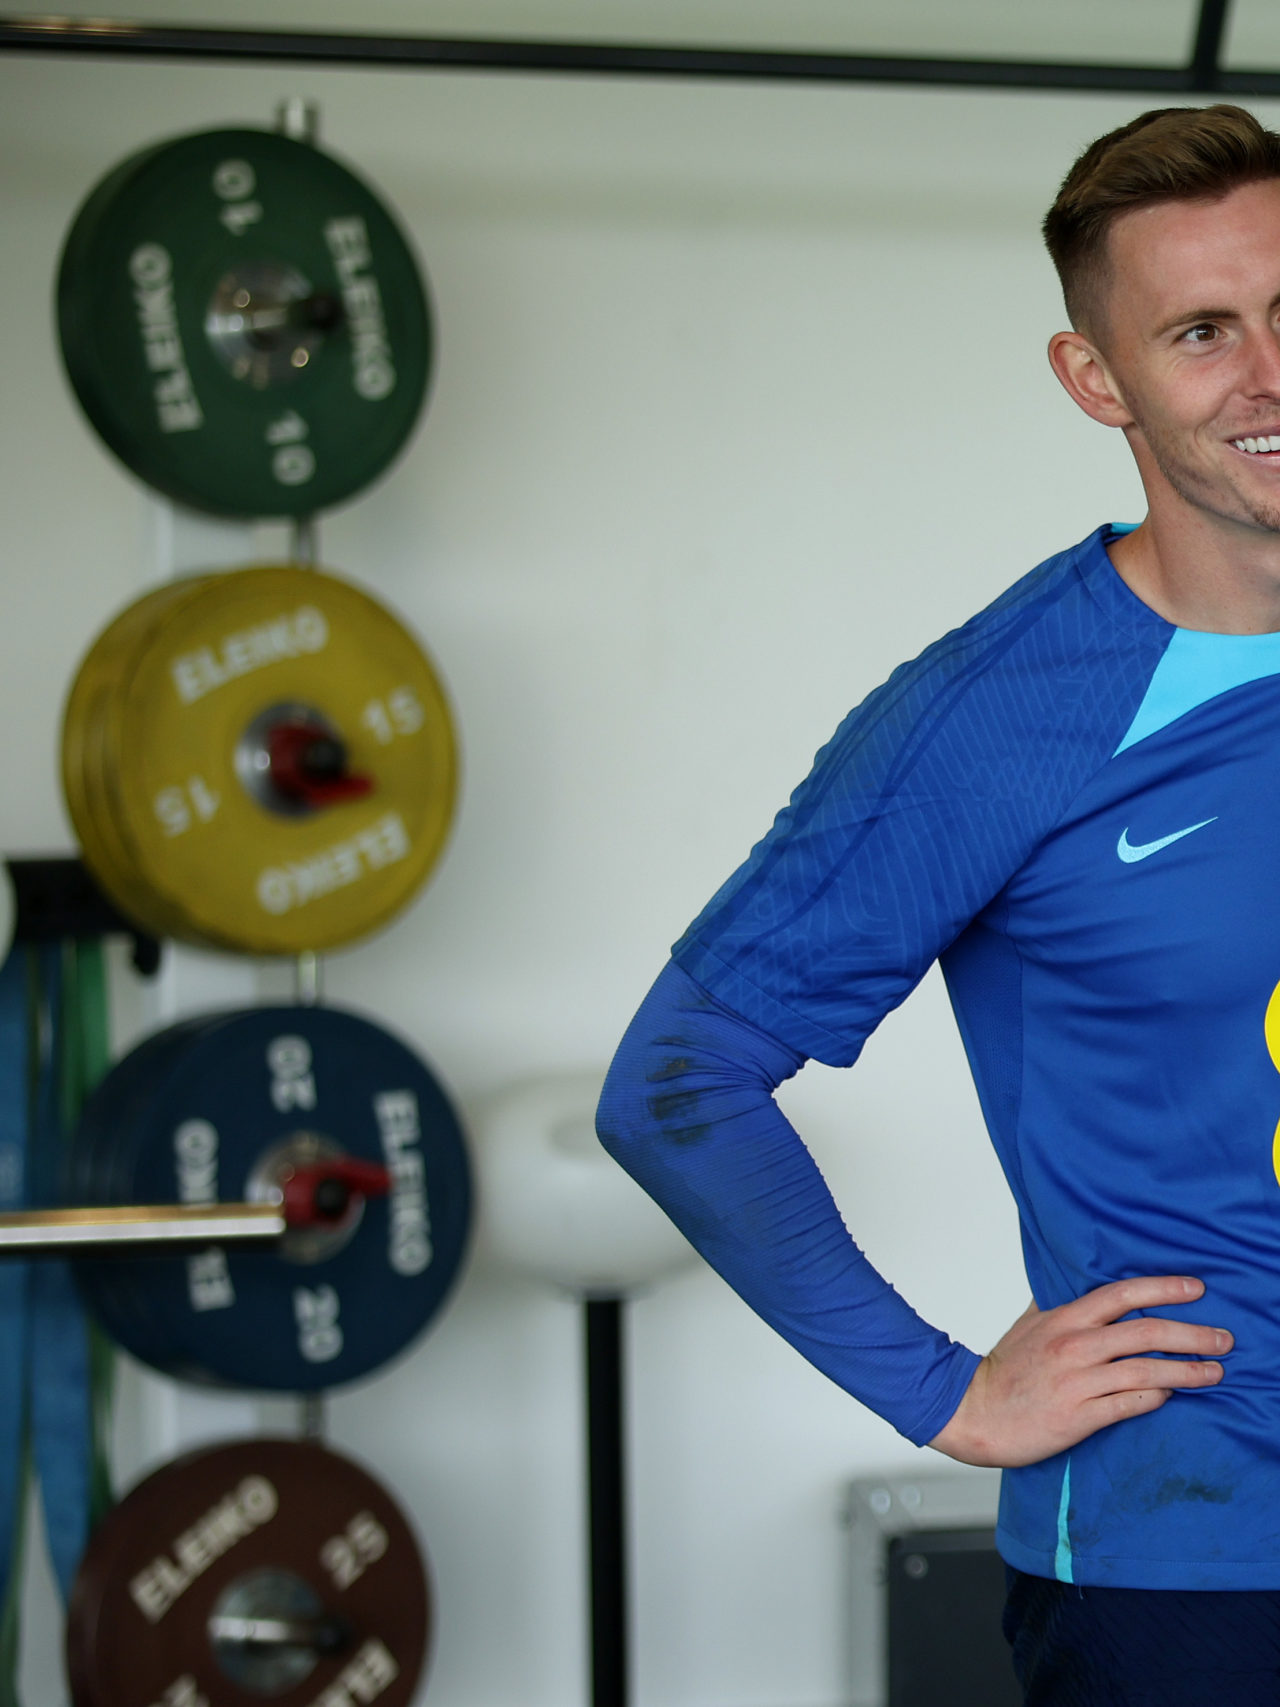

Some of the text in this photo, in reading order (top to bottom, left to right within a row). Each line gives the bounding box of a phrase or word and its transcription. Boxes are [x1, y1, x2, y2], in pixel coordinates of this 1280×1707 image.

[129, 241, 205, 434] ELEIKO
[324, 215, 396, 401] ELEIKO
[171, 605, 330, 706] ELEIKO
[361, 683, 426, 746] 15
[153, 775, 220, 837] 15
[256, 812, 410, 915] ELEIKO
[266, 1034, 317, 1114] 20
[372, 1088, 433, 1277] ELEIKO
[293, 1284, 344, 1363] 20
[129, 1474, 279, 1623] ELEIKO
[320, 1511, 389, 1590] 25
